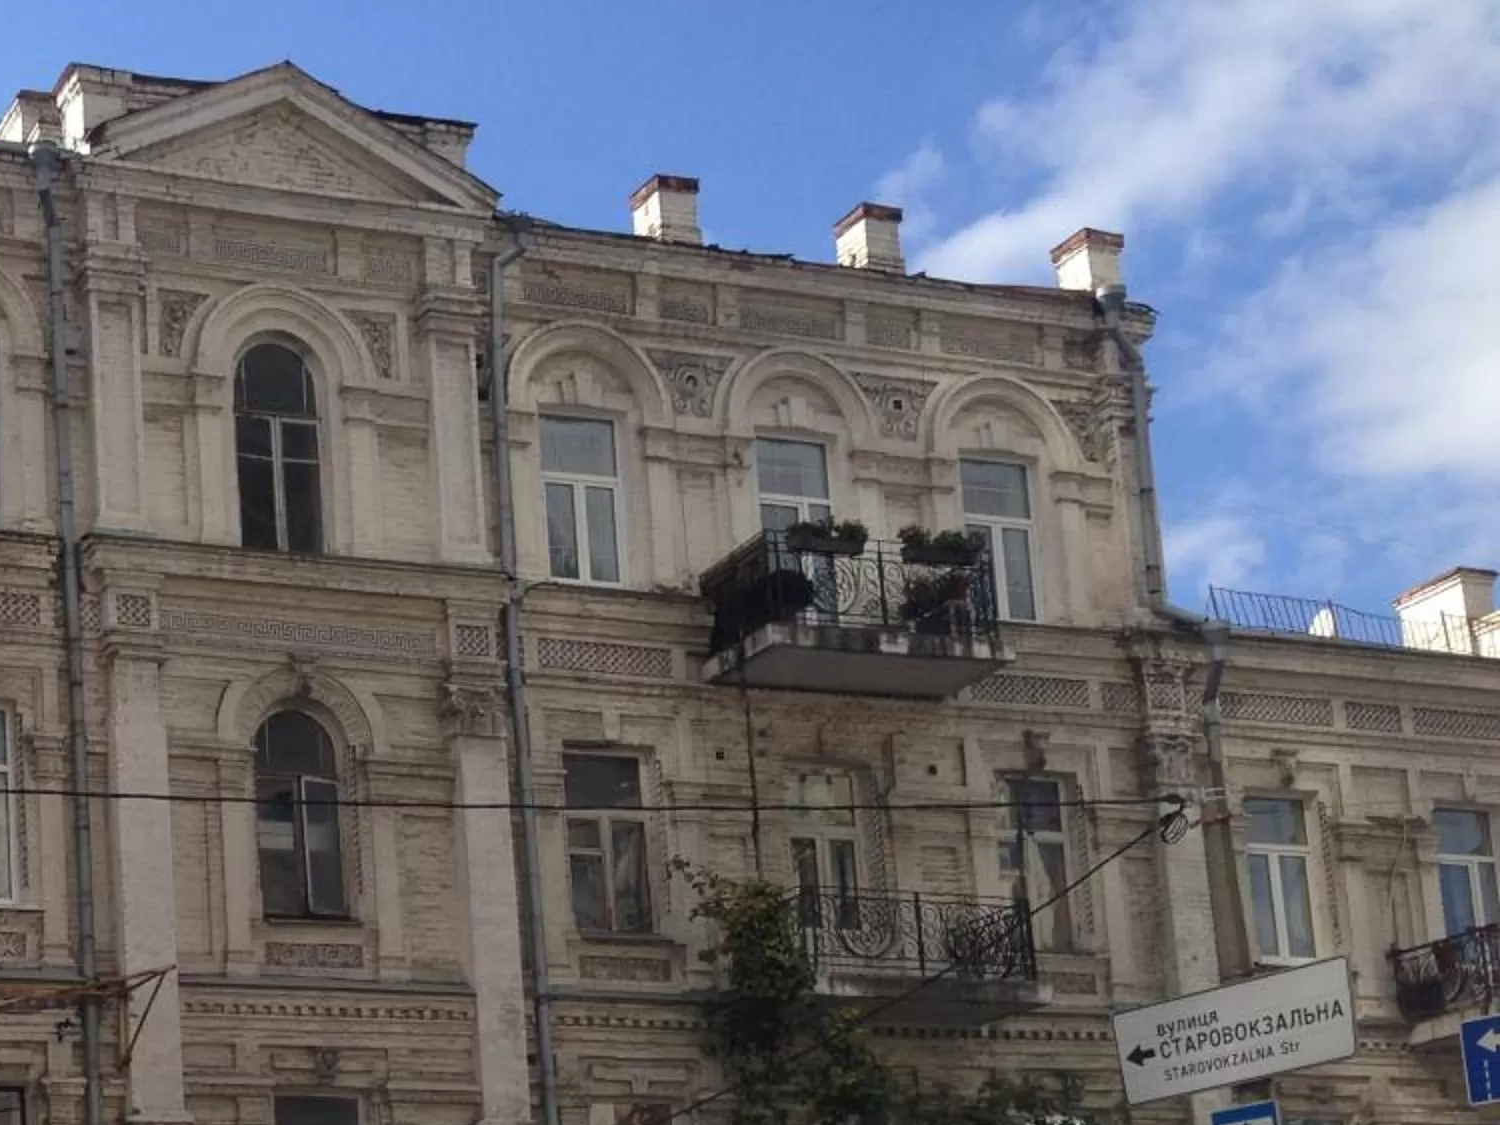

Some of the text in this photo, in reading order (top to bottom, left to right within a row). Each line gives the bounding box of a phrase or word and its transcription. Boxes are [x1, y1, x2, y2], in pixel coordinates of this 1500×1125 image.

[1159, 1000, 1345, 1059] СТАРОВОКЗАЛЬНА
[1163, 1041, 1300, 1082] STAROVOKZALNA Str
